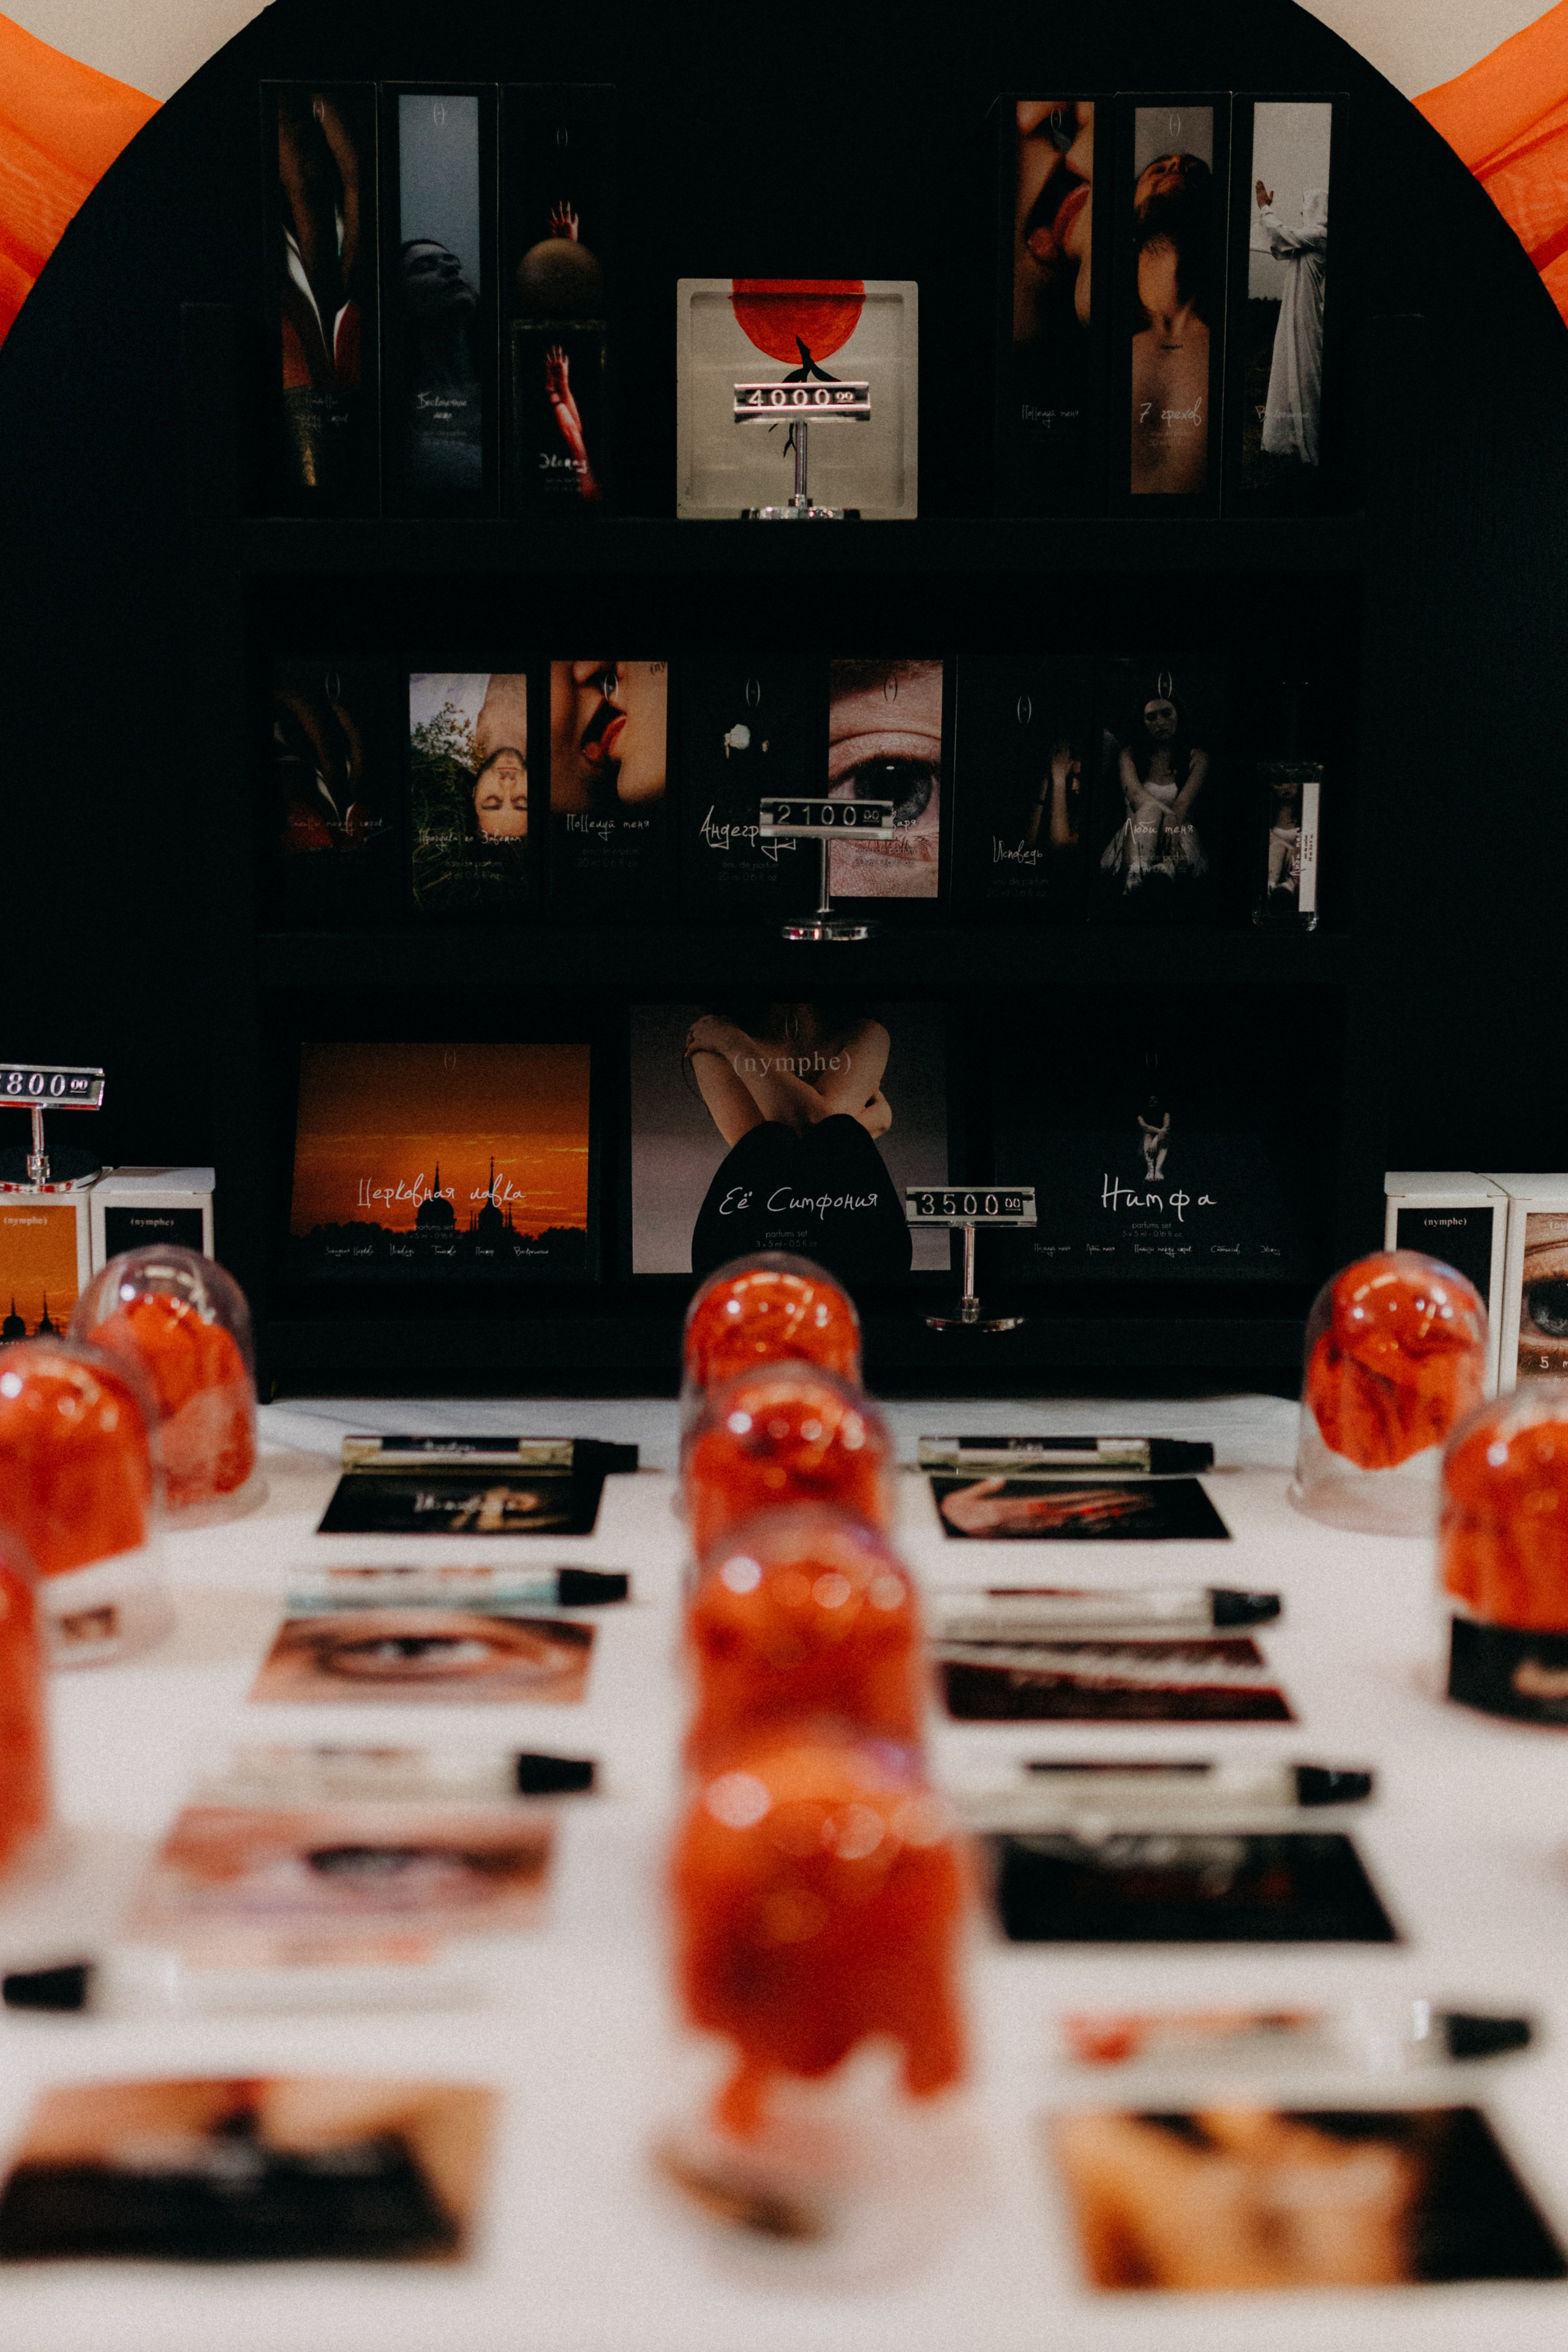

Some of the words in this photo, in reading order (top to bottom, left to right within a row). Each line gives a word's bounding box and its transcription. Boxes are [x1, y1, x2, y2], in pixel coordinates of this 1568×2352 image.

[748, 389, 831, 405] 4000
[1140, 403, 1152, 423] 7
[1161, 397, 1202, 427] грехов
[623, 820, 650, 829] меня
[777, 805, 856, 825] 2100
[863, 810, 880, 820] 00
[1125, 818, 1158, 844] Люби
[1165, 824, 1194, 835] меня
[993, 835, 1043, 865] Исповедь
[733, 1051, 852, 1078] (nymphe)
[0, 1072, 66, 1097] 800
[70, 1079, 88, 1090] 00
[357, 1174, 455, 1208] Церковная
[470, 1174, 527, 1208] лавка
[1101, 1173, 1218, 1222] Нимфа
[719, 1186, 753, 1215] Её
[767, 1186, 878, 1221] Симфония
[921, 1194, 998, 1215] 3500
[1005, 1198, 1020, 1208] 00
[3, 1216, 48, 1226] (nymphe)
[130, 1218, 174, 1227] (nymphe)
[1132, 1221, 1159, 1230] parfums
[1423, 1218, 1467, 1227] (nymphe)
[765, 1229, 795, 1239] parfums
[1540, 1355, 1549, 1369] 5
